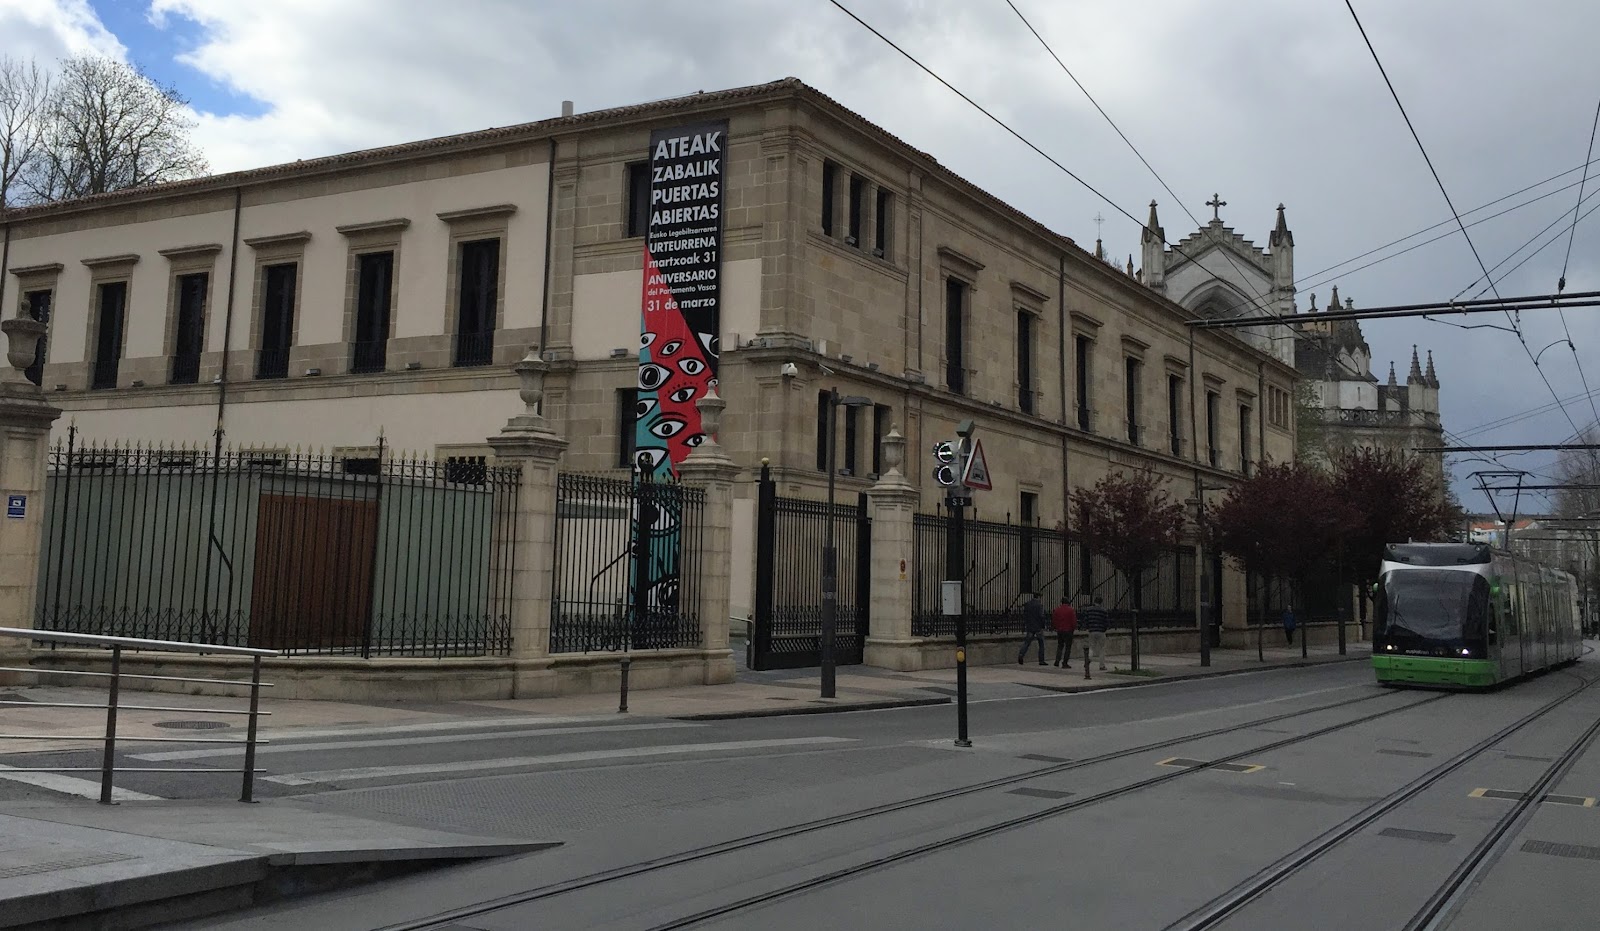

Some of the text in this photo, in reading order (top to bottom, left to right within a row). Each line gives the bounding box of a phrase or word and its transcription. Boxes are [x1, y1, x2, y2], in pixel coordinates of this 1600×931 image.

[653, 131, 721, 160] ATEAK
[653, 159, 720, 183] ZABALIK
[652, 181, 719, 205] PUERTAS
[651, 203, 719, 226] ABIERTAS
[650, 226, 718, 239] Eusko Legebiltzarraren
[650, 236, 717, 254] URTEURRENA
[649, 251, 716, 268] martxoak 31
[648, 268, 717, 285] ANIVERSARIO
[648, 284, 717, 296] del Parlamento Vasco
[647, 297, 717, 312] 31 de marzo
